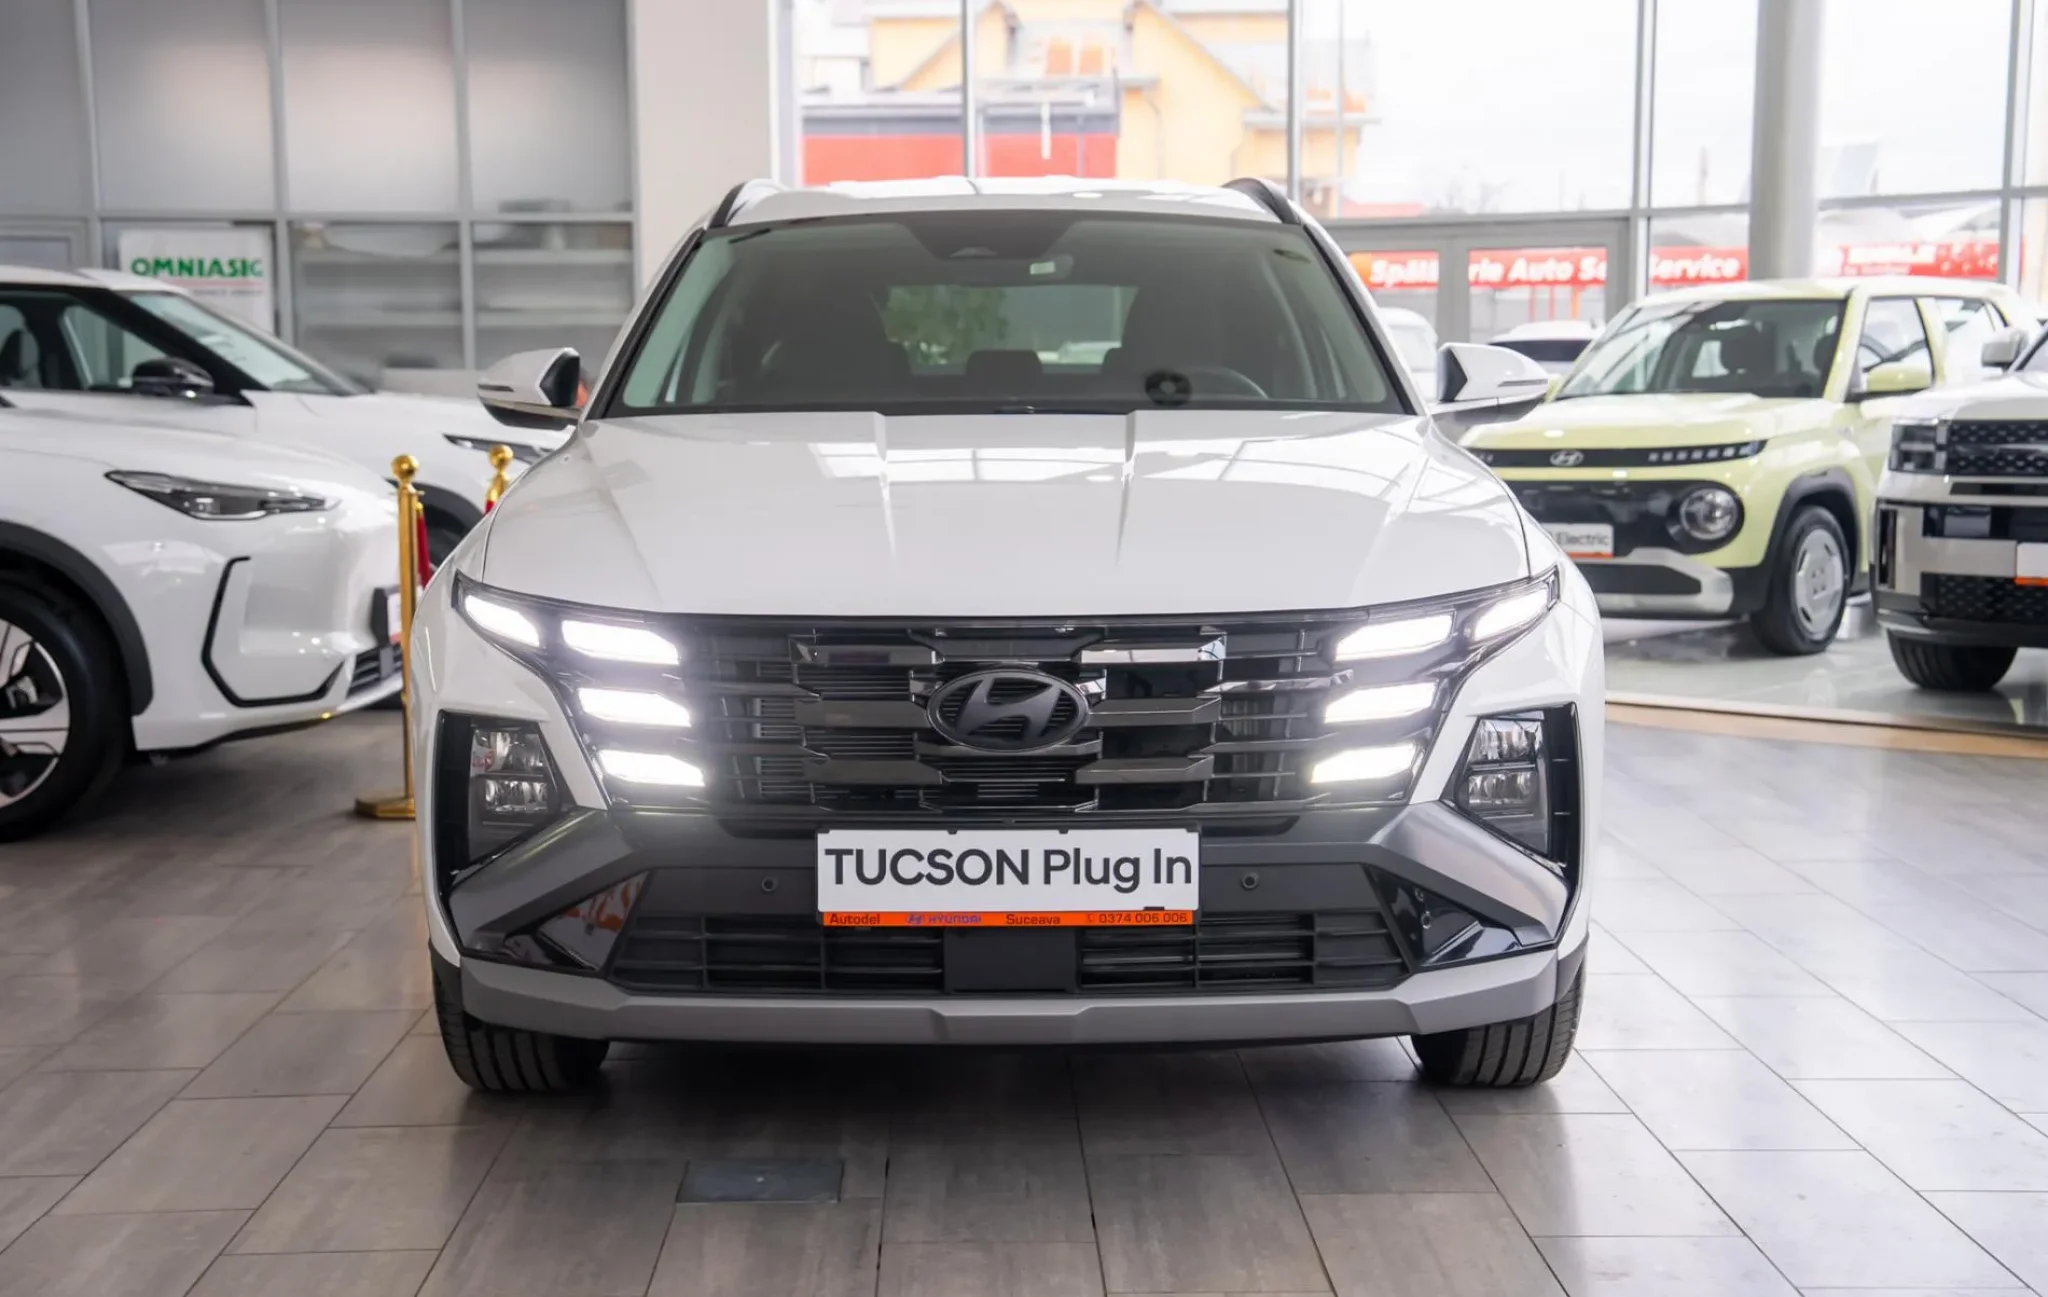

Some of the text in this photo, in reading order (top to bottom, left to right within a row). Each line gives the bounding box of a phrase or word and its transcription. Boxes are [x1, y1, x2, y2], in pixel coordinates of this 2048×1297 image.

[825, 847, 1192, 893] TUCSON Plug In
[829, 912, 1187, 925] Autodel HYUNDAI Suceava 0374 006 006
